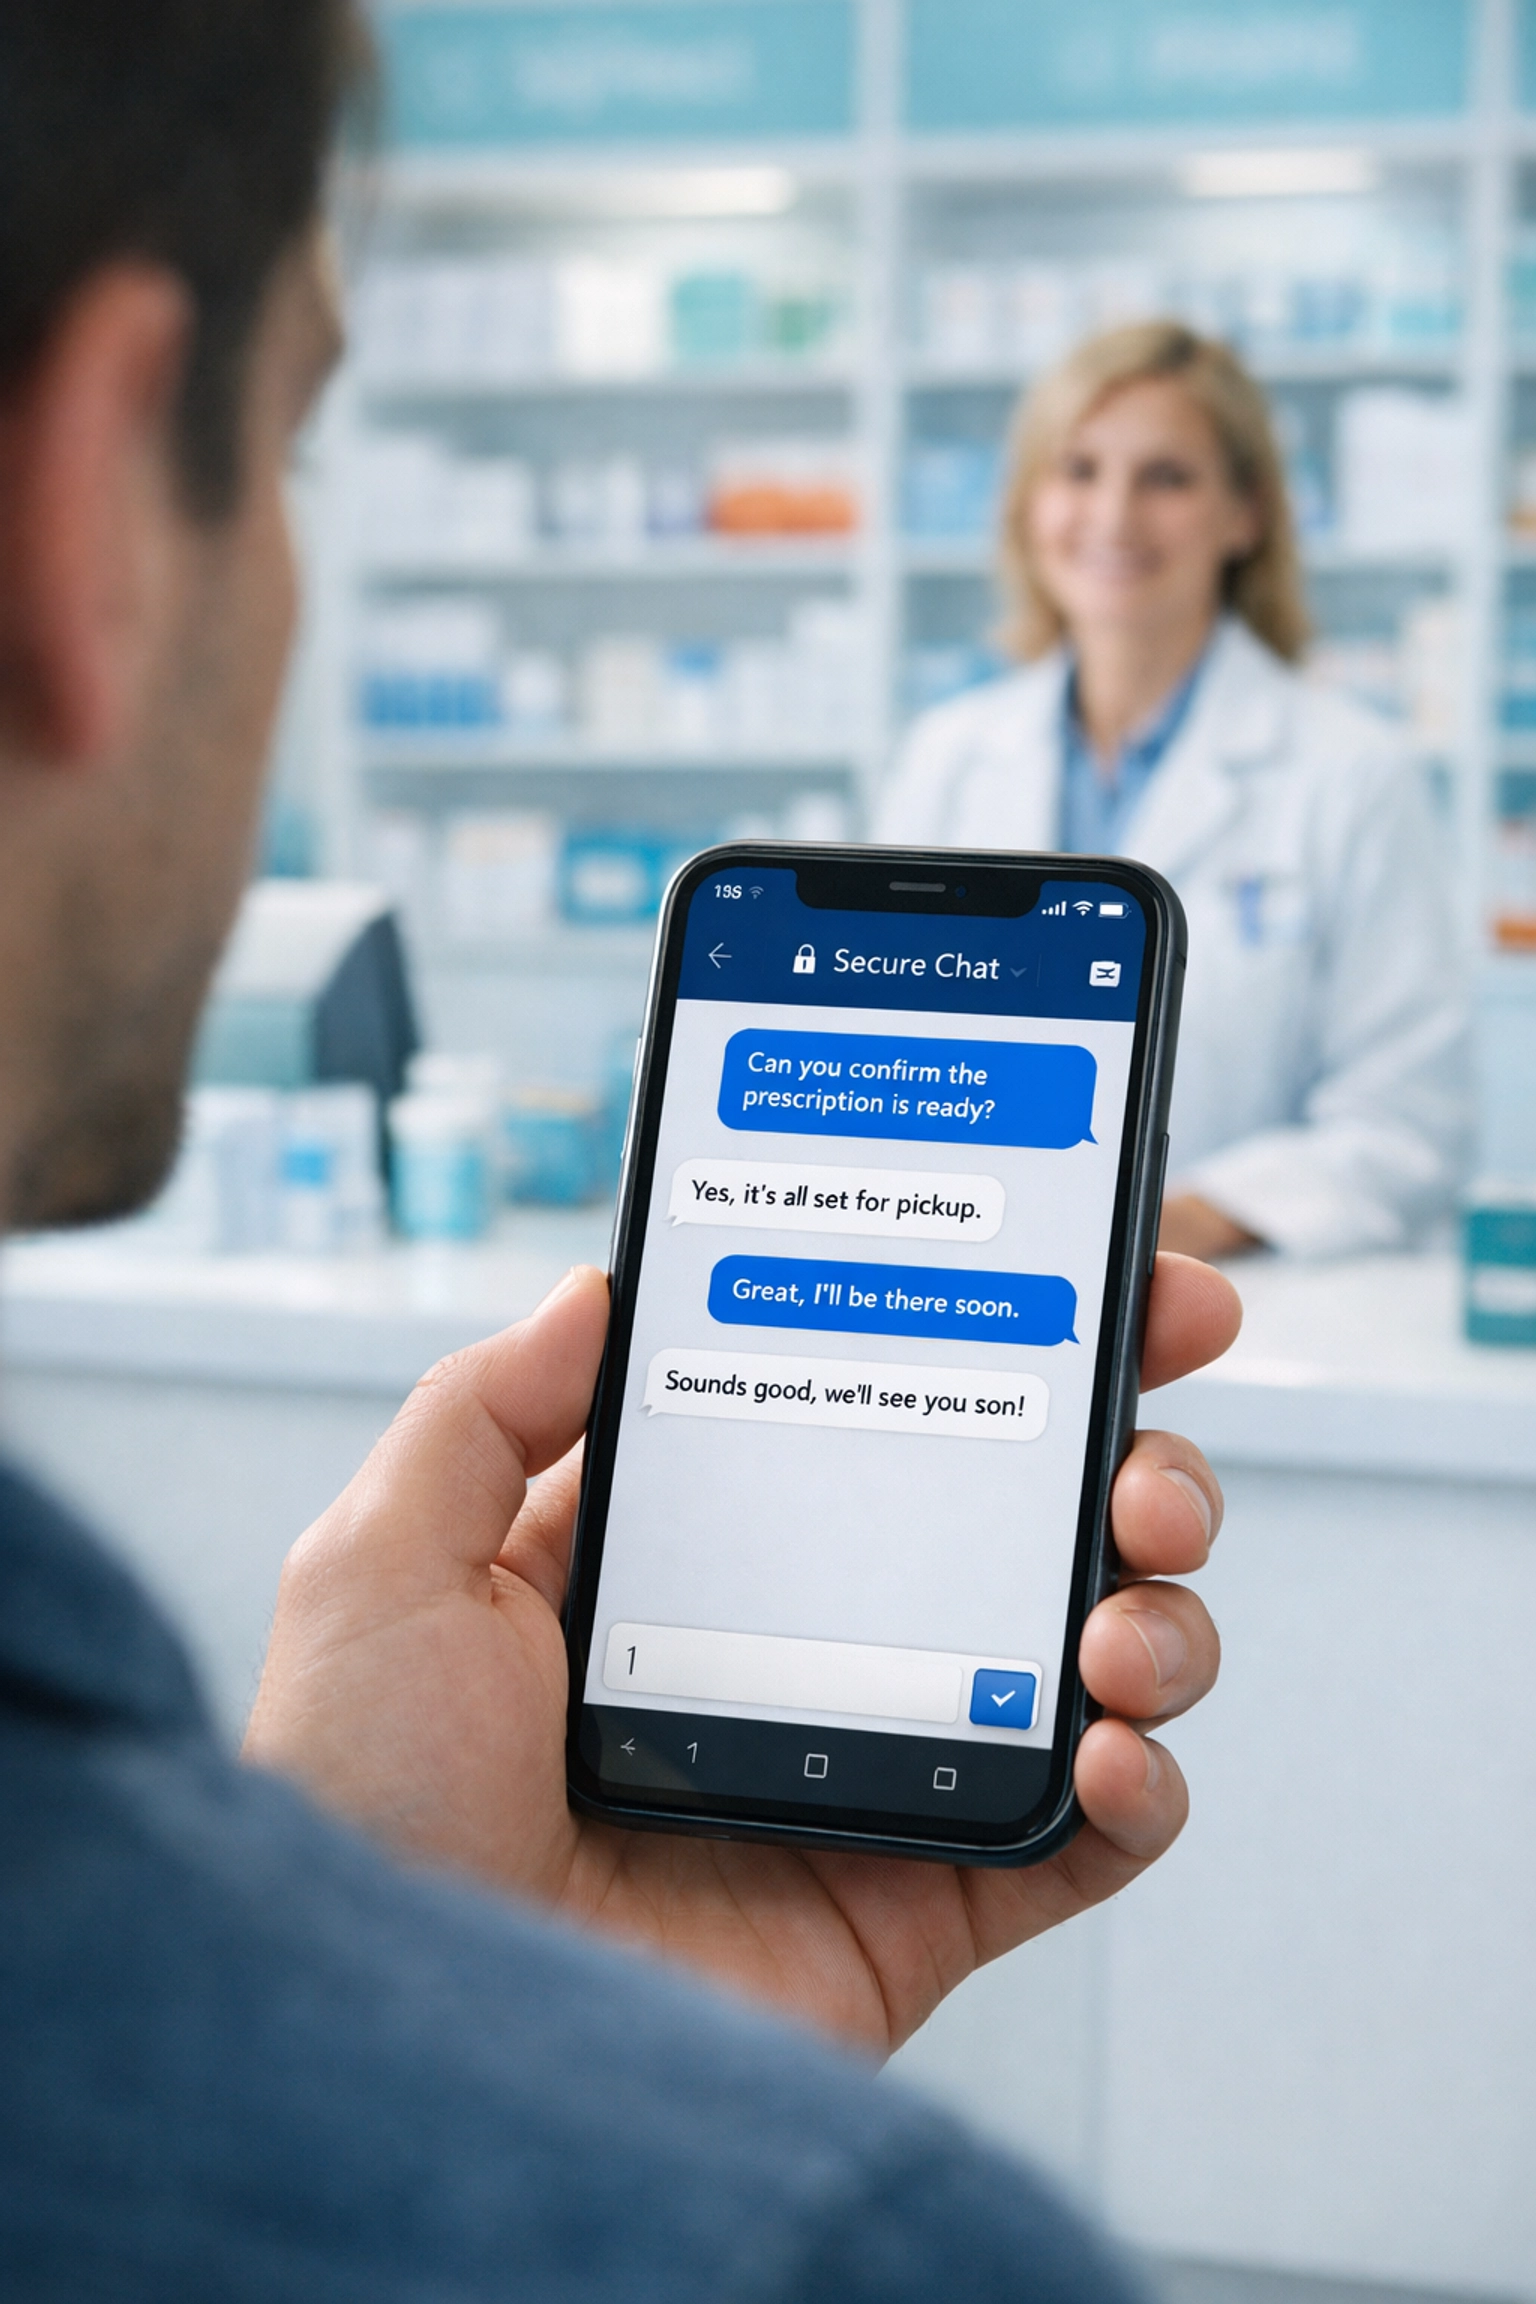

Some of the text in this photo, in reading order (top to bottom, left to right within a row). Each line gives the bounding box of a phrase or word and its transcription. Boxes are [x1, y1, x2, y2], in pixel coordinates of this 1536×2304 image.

[833, 948, 1001, 980] Secure Chat
[748, 1051, 988, 1086] Can you confirm the
[742, 1088, 996, 1125] prescription is ready?
[691, 1179, 981, 1224] Yes, it's all set for pickup.
[732, 1278, 1019, 1318] Great, I'll be there soon.
[665, 1369, 1025, 1417] Sounds good, we'll see you son!
